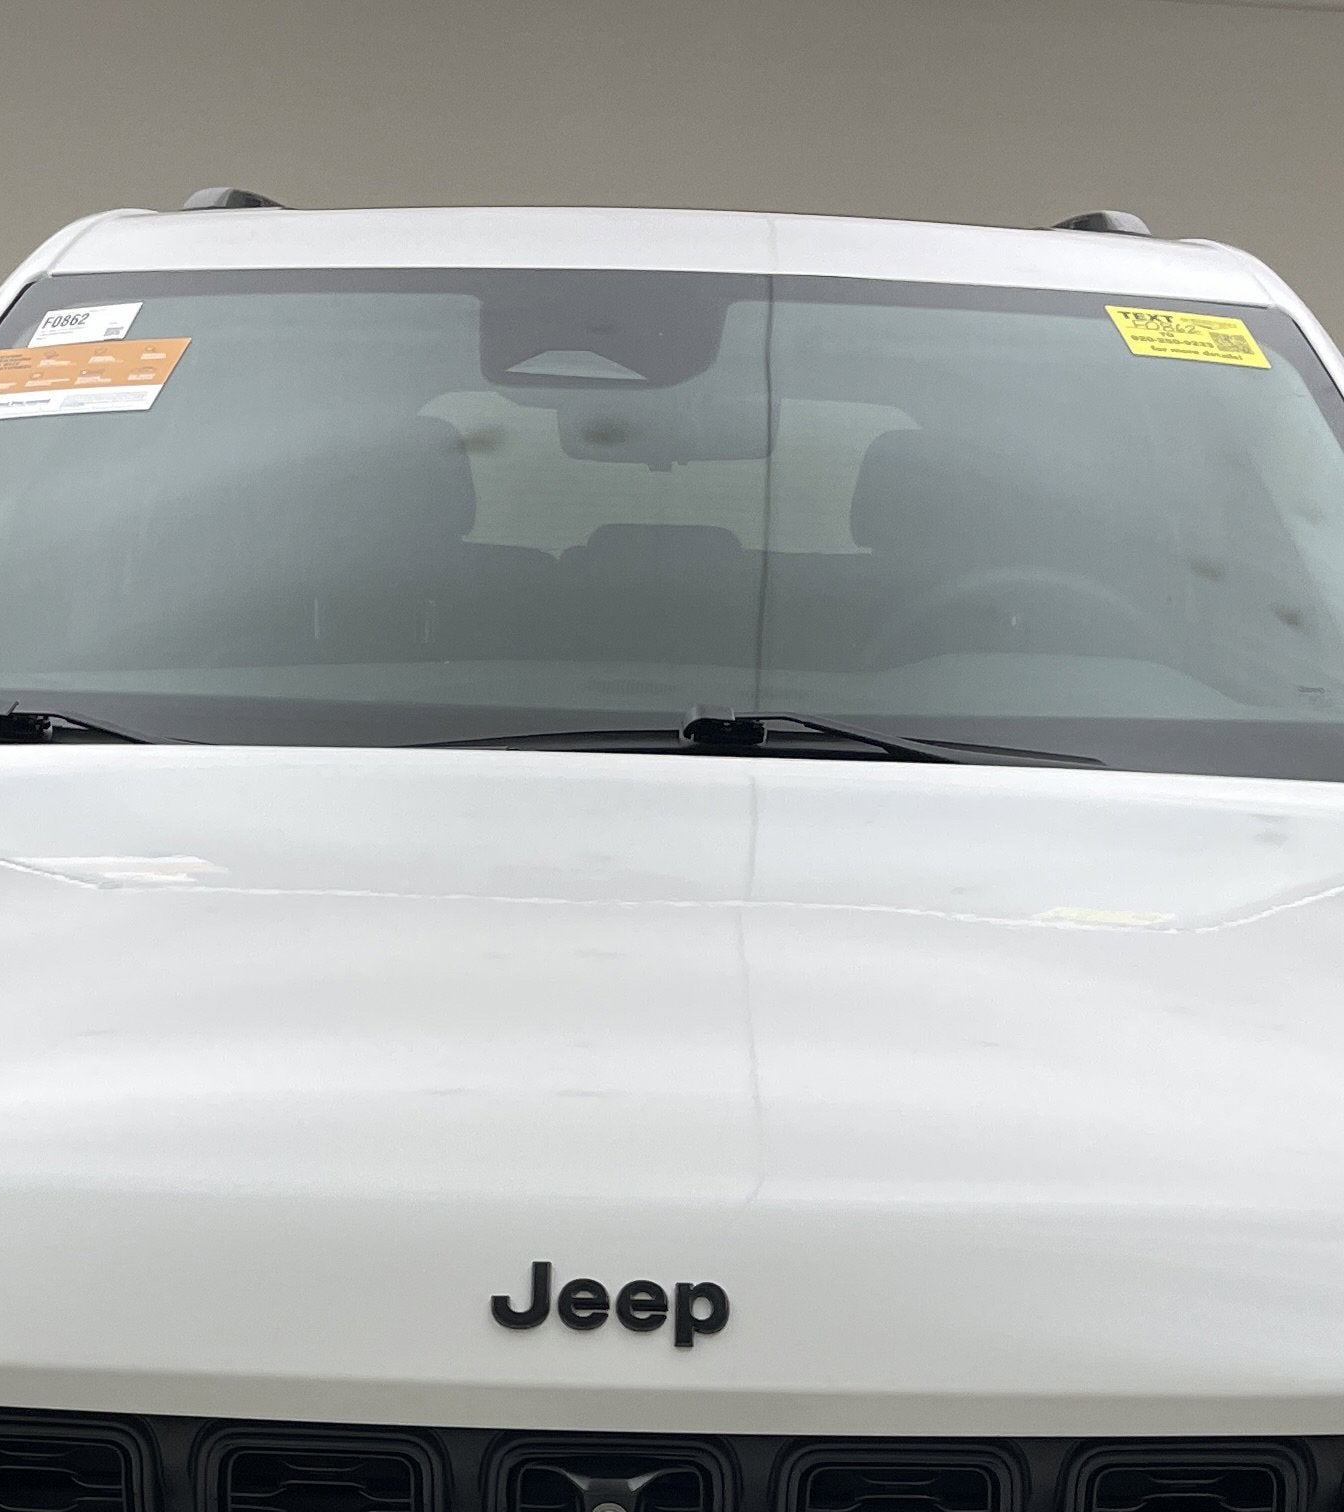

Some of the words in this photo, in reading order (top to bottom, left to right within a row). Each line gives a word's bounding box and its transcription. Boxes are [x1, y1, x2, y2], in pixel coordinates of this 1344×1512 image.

[42, 312, 90, 330] F0862
[1117, 311, 1174, 324] TEXT
[490, 1260, 730, 1348] Jeep
